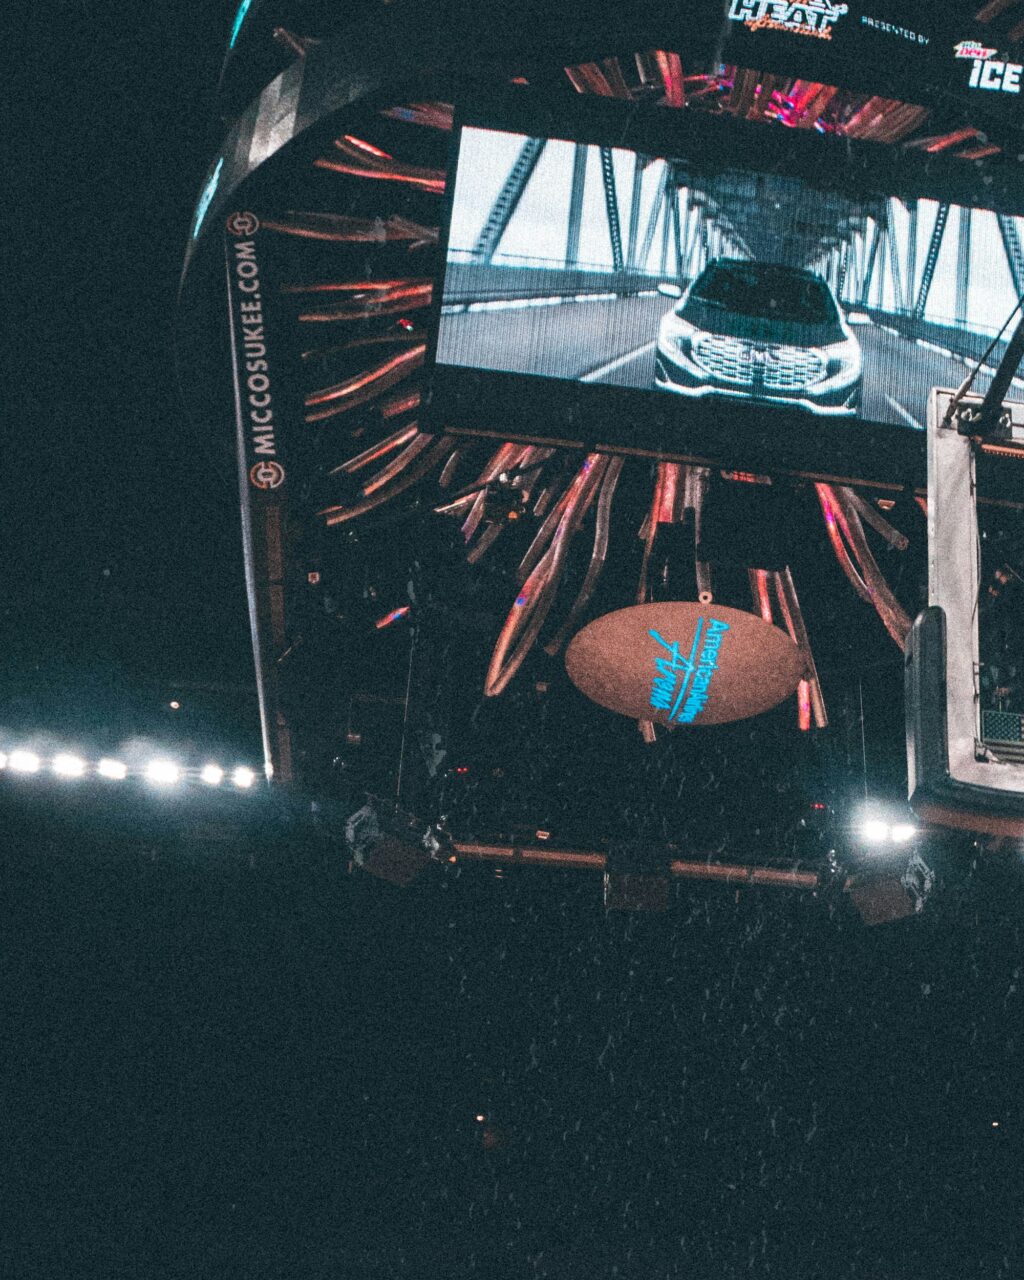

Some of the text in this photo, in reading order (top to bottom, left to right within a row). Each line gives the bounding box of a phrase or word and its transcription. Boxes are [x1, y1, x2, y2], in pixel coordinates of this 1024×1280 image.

[861, 15, 930, 45] PRESENTED BY
[968, 59, 1024, 94] ICE
[233, 240, 277, 455] MICCOSUKEE.COM
